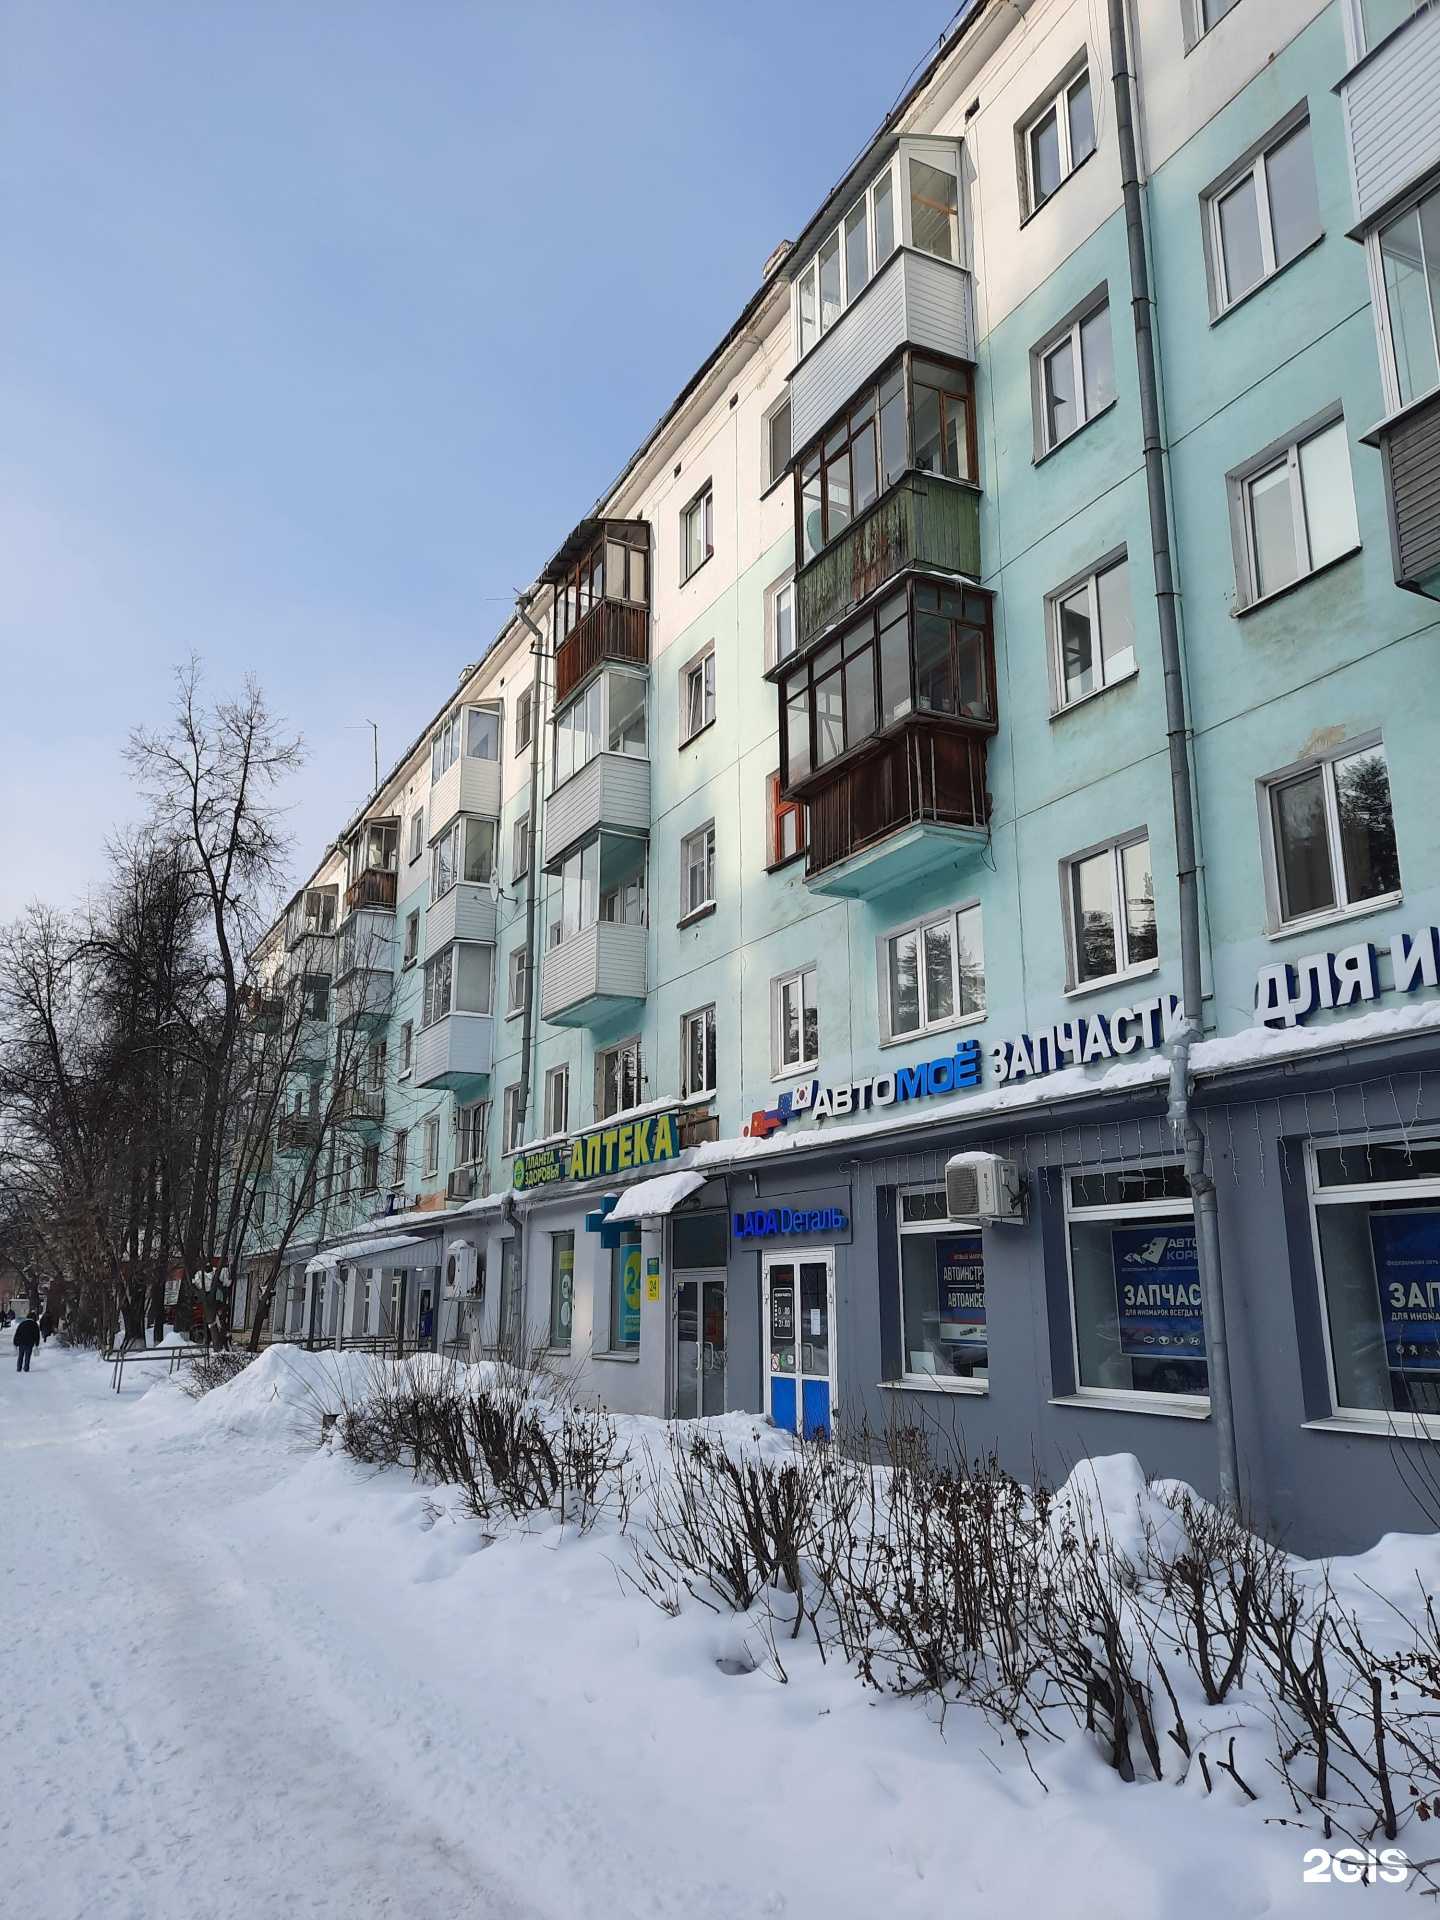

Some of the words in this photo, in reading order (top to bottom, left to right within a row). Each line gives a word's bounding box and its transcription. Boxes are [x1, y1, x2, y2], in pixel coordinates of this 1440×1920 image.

[1254, 942, 1380, 1028] ДЛЯ
[568, 1115, 675, 1180] АПТЕКА
[525, 1150, 555, 1169] ПЛАНЕТА
[524, 1164, 560, 1184] ЗДОРОВЬЯ
[733, 1210, 778, 1239] LADA
[649, 1279, 657, 1292] 24
[1391, 1312, 1409, 1321] ДЛЯ
